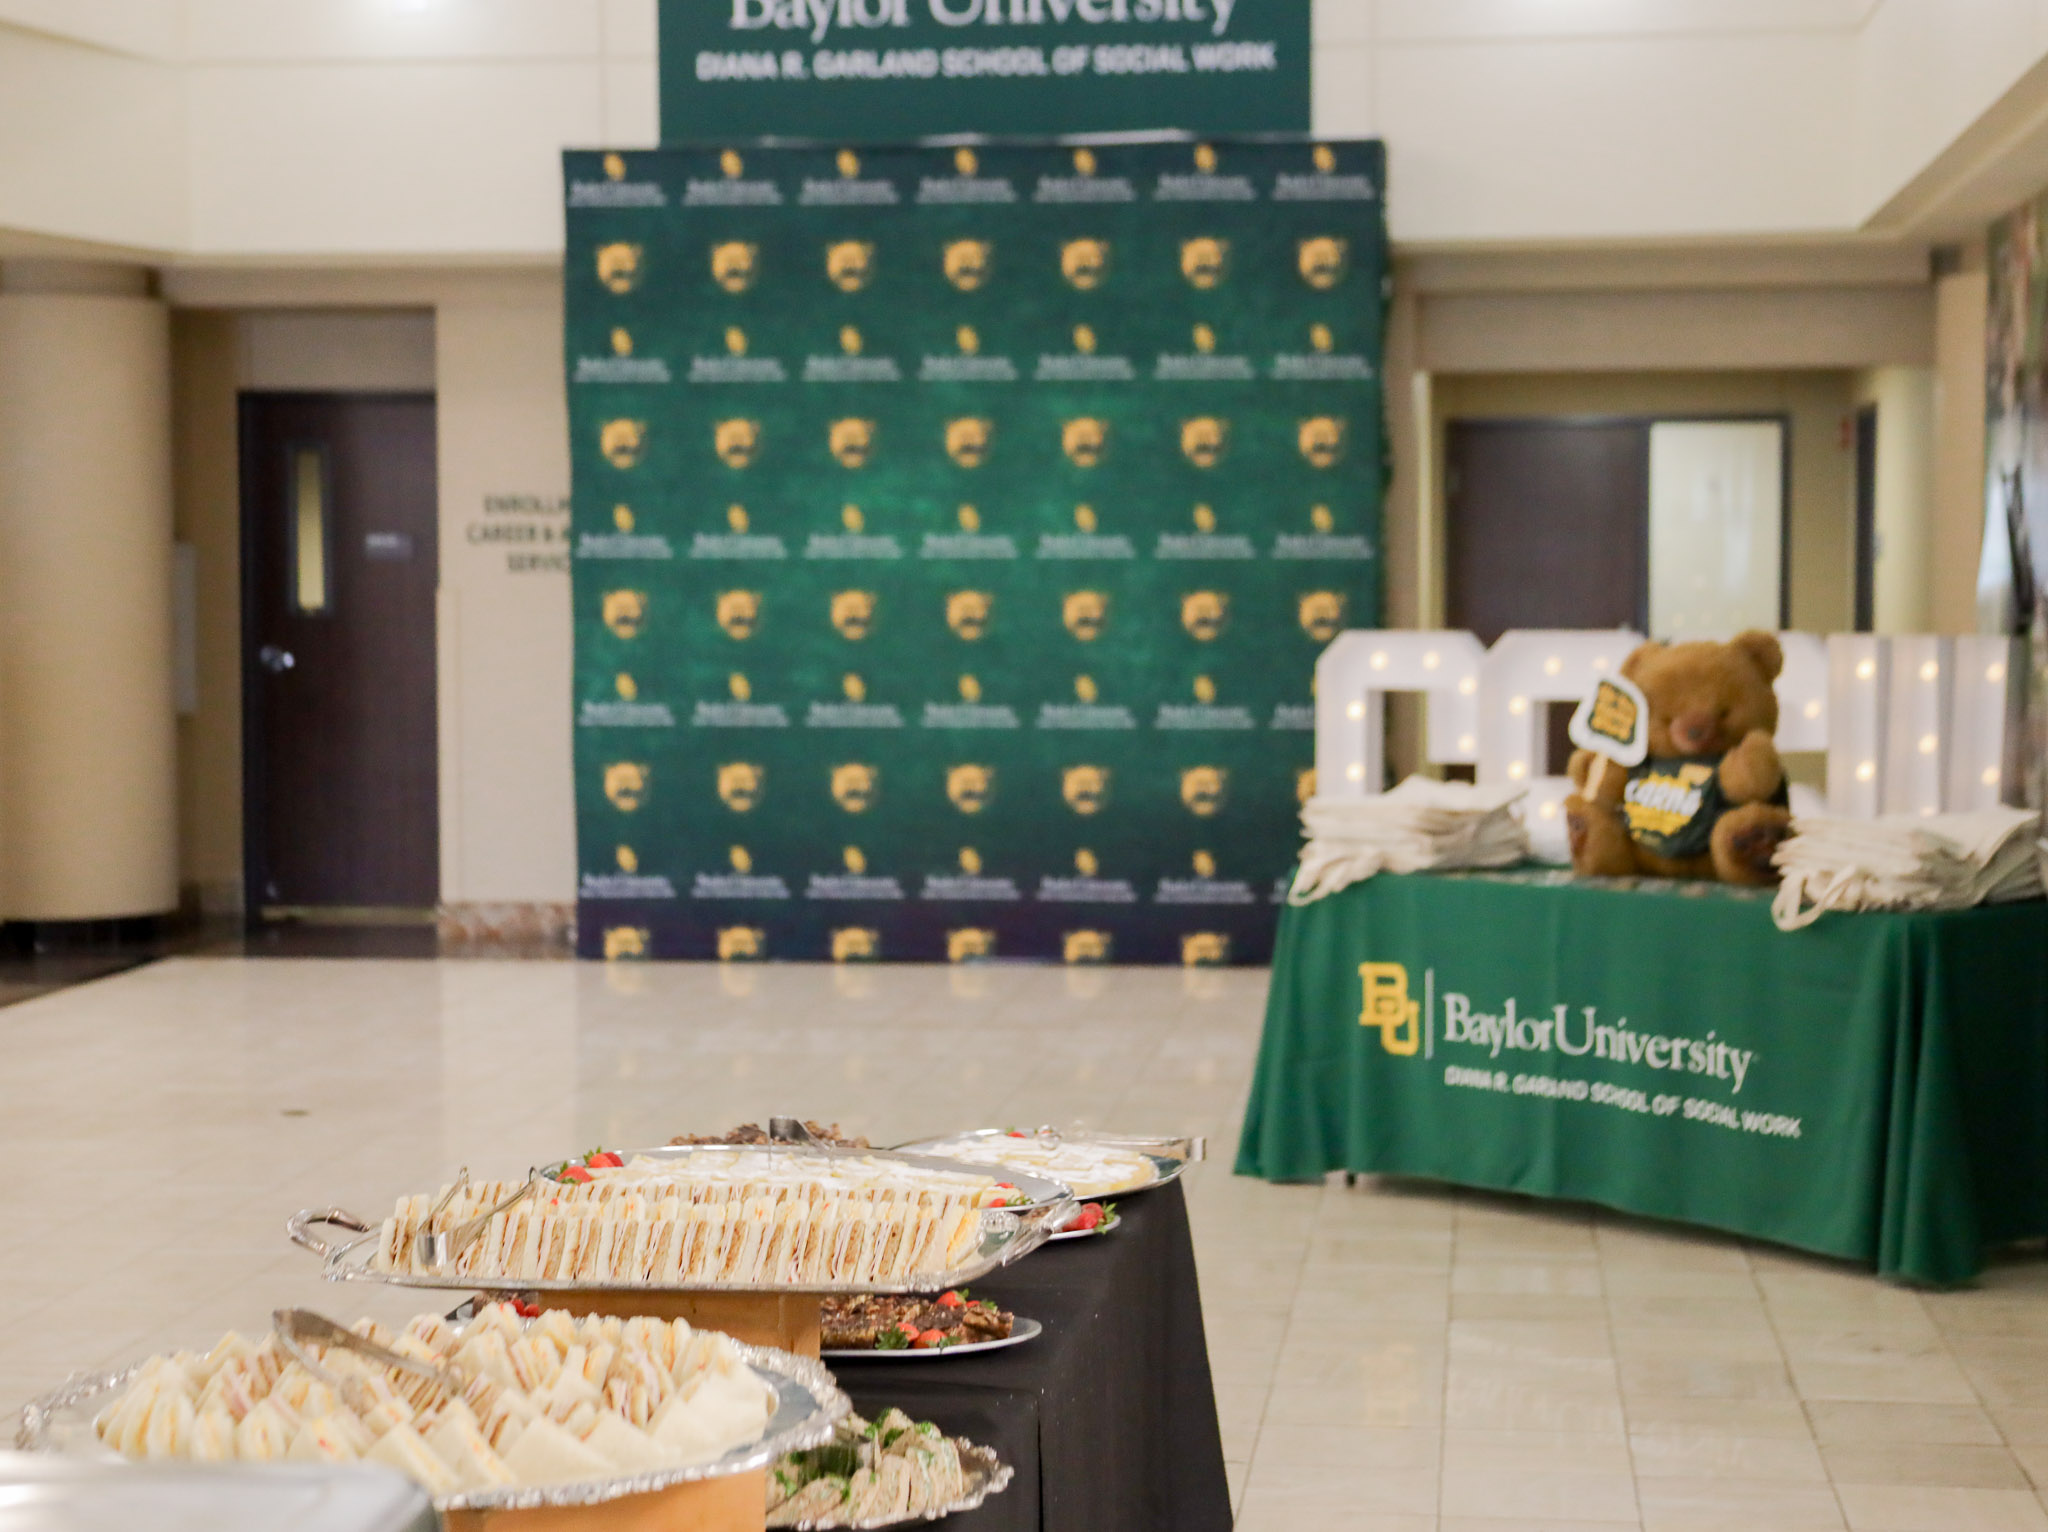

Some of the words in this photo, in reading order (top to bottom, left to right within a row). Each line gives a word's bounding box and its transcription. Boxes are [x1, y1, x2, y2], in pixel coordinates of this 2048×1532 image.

[695, 50, 779, 81] DIANA
[812, 48, 940, 80] GARLAND
[941, 46, 1049, 77] SCHOOL
[1051, 45, 1090, 76] OF
[1093, 43, 1189, 75] SOCIAL
[1190, 40, 1277, 72] WORK
[1444, 1065, 1492, 1090] DIANA
[1512, 1073, 1589, 1101] GARLAND
[1590, 1081, 1650, 1114] SCHOOL
[1651, 1093, 1682, 1116] OF
[1682, 1097, 1740, 1130] SOCIAL
[1740, 1110, 1803, 1139] WORK
